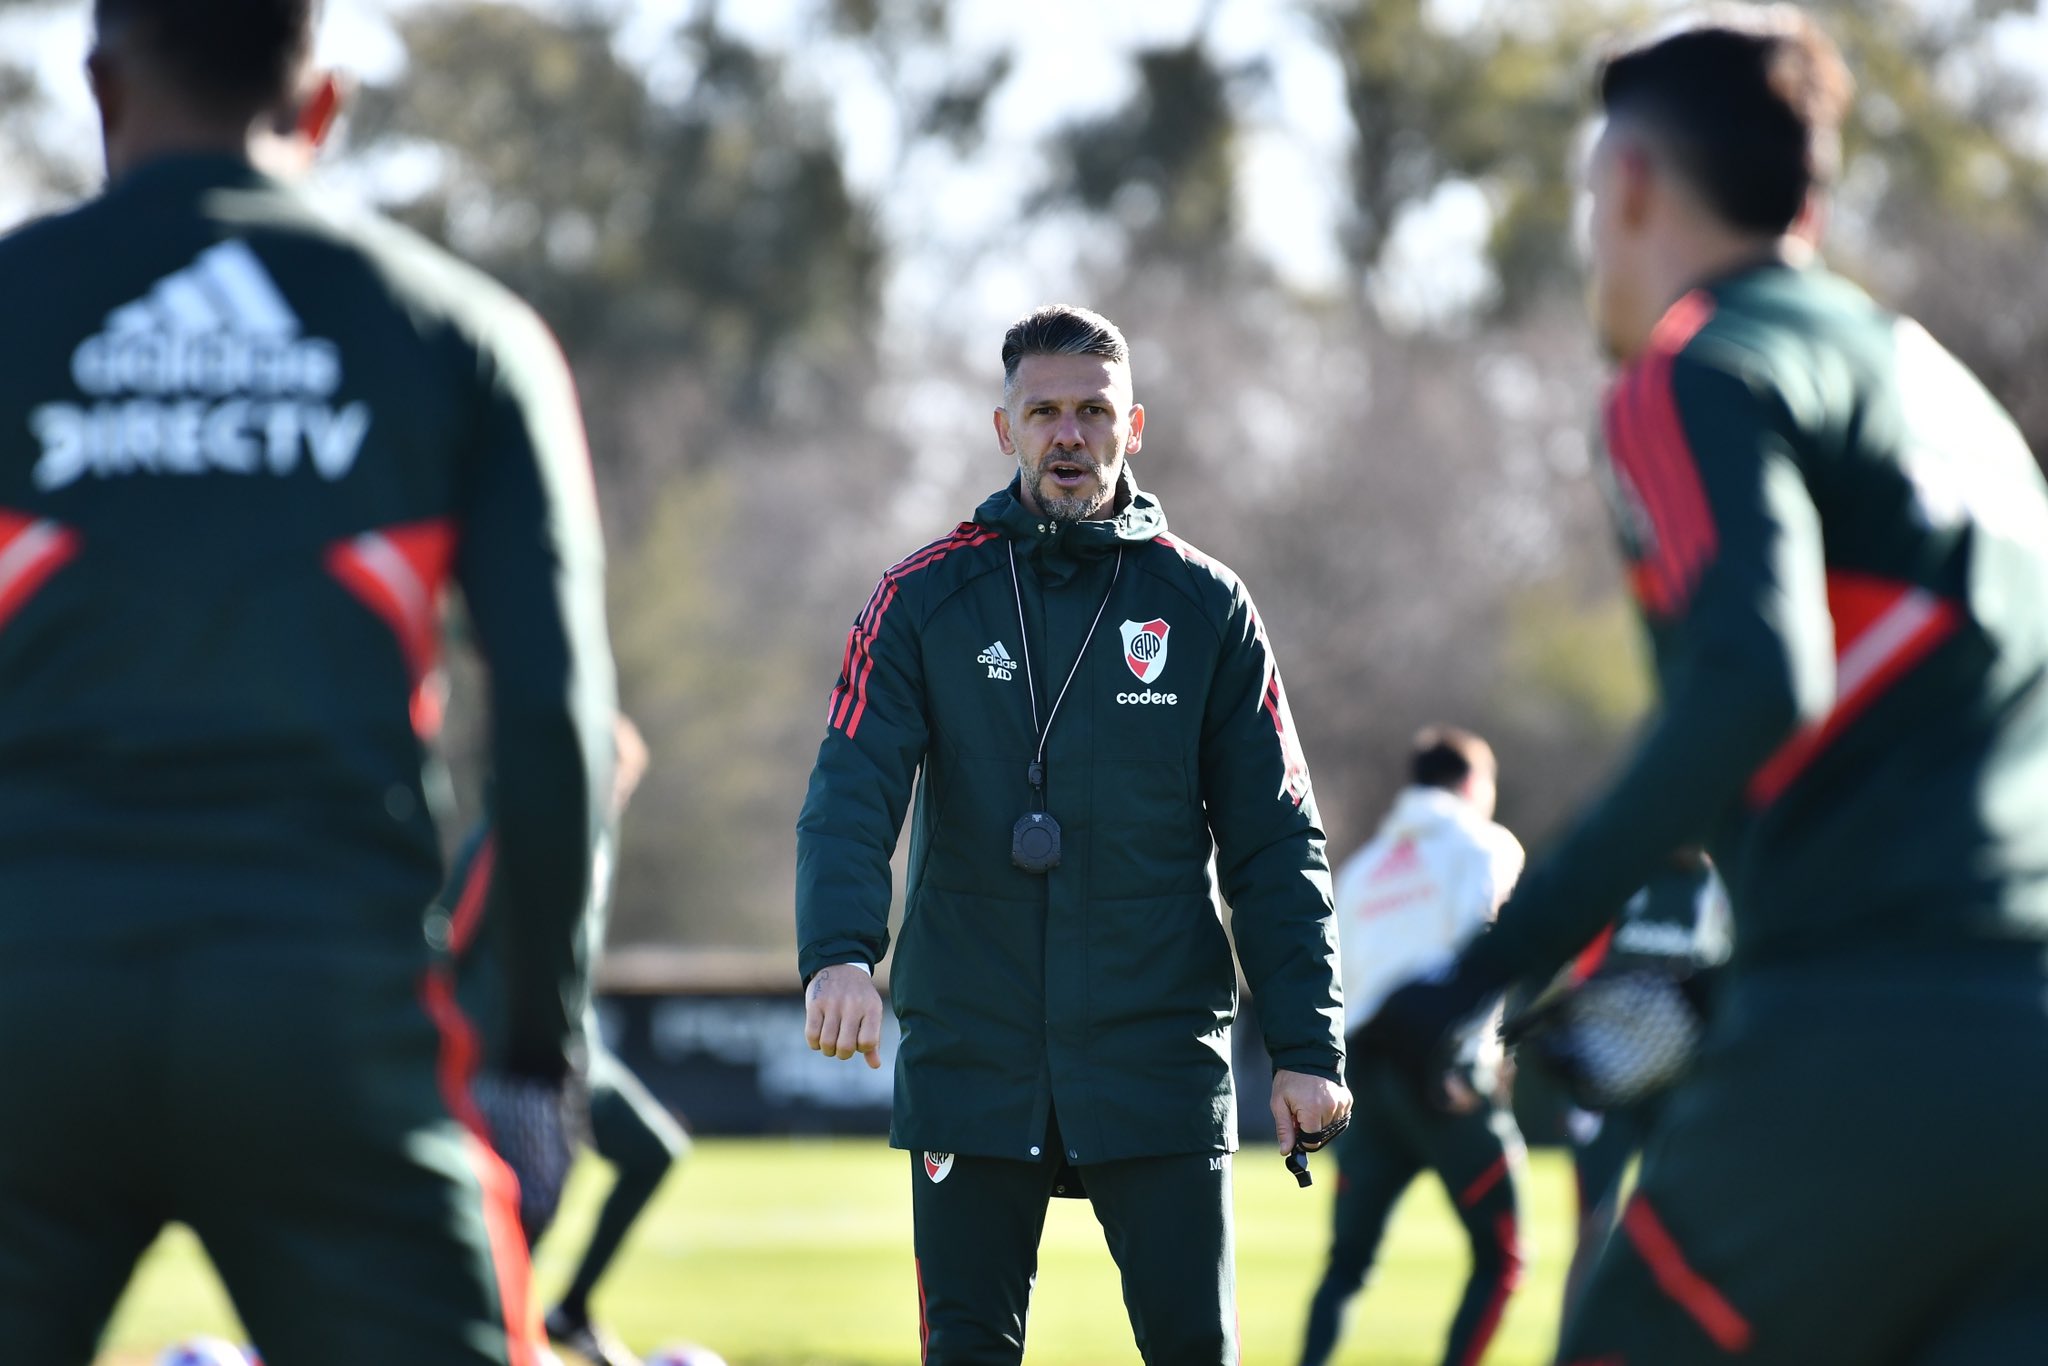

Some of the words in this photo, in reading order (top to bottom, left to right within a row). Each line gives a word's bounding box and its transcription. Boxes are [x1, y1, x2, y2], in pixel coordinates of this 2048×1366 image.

[1130, 632, 1161, 661] CARP
[977, 654, 1018, 670] adidas
[987, 665, 1012, 681] MD
[1116, 688, 1178, 706] codere
